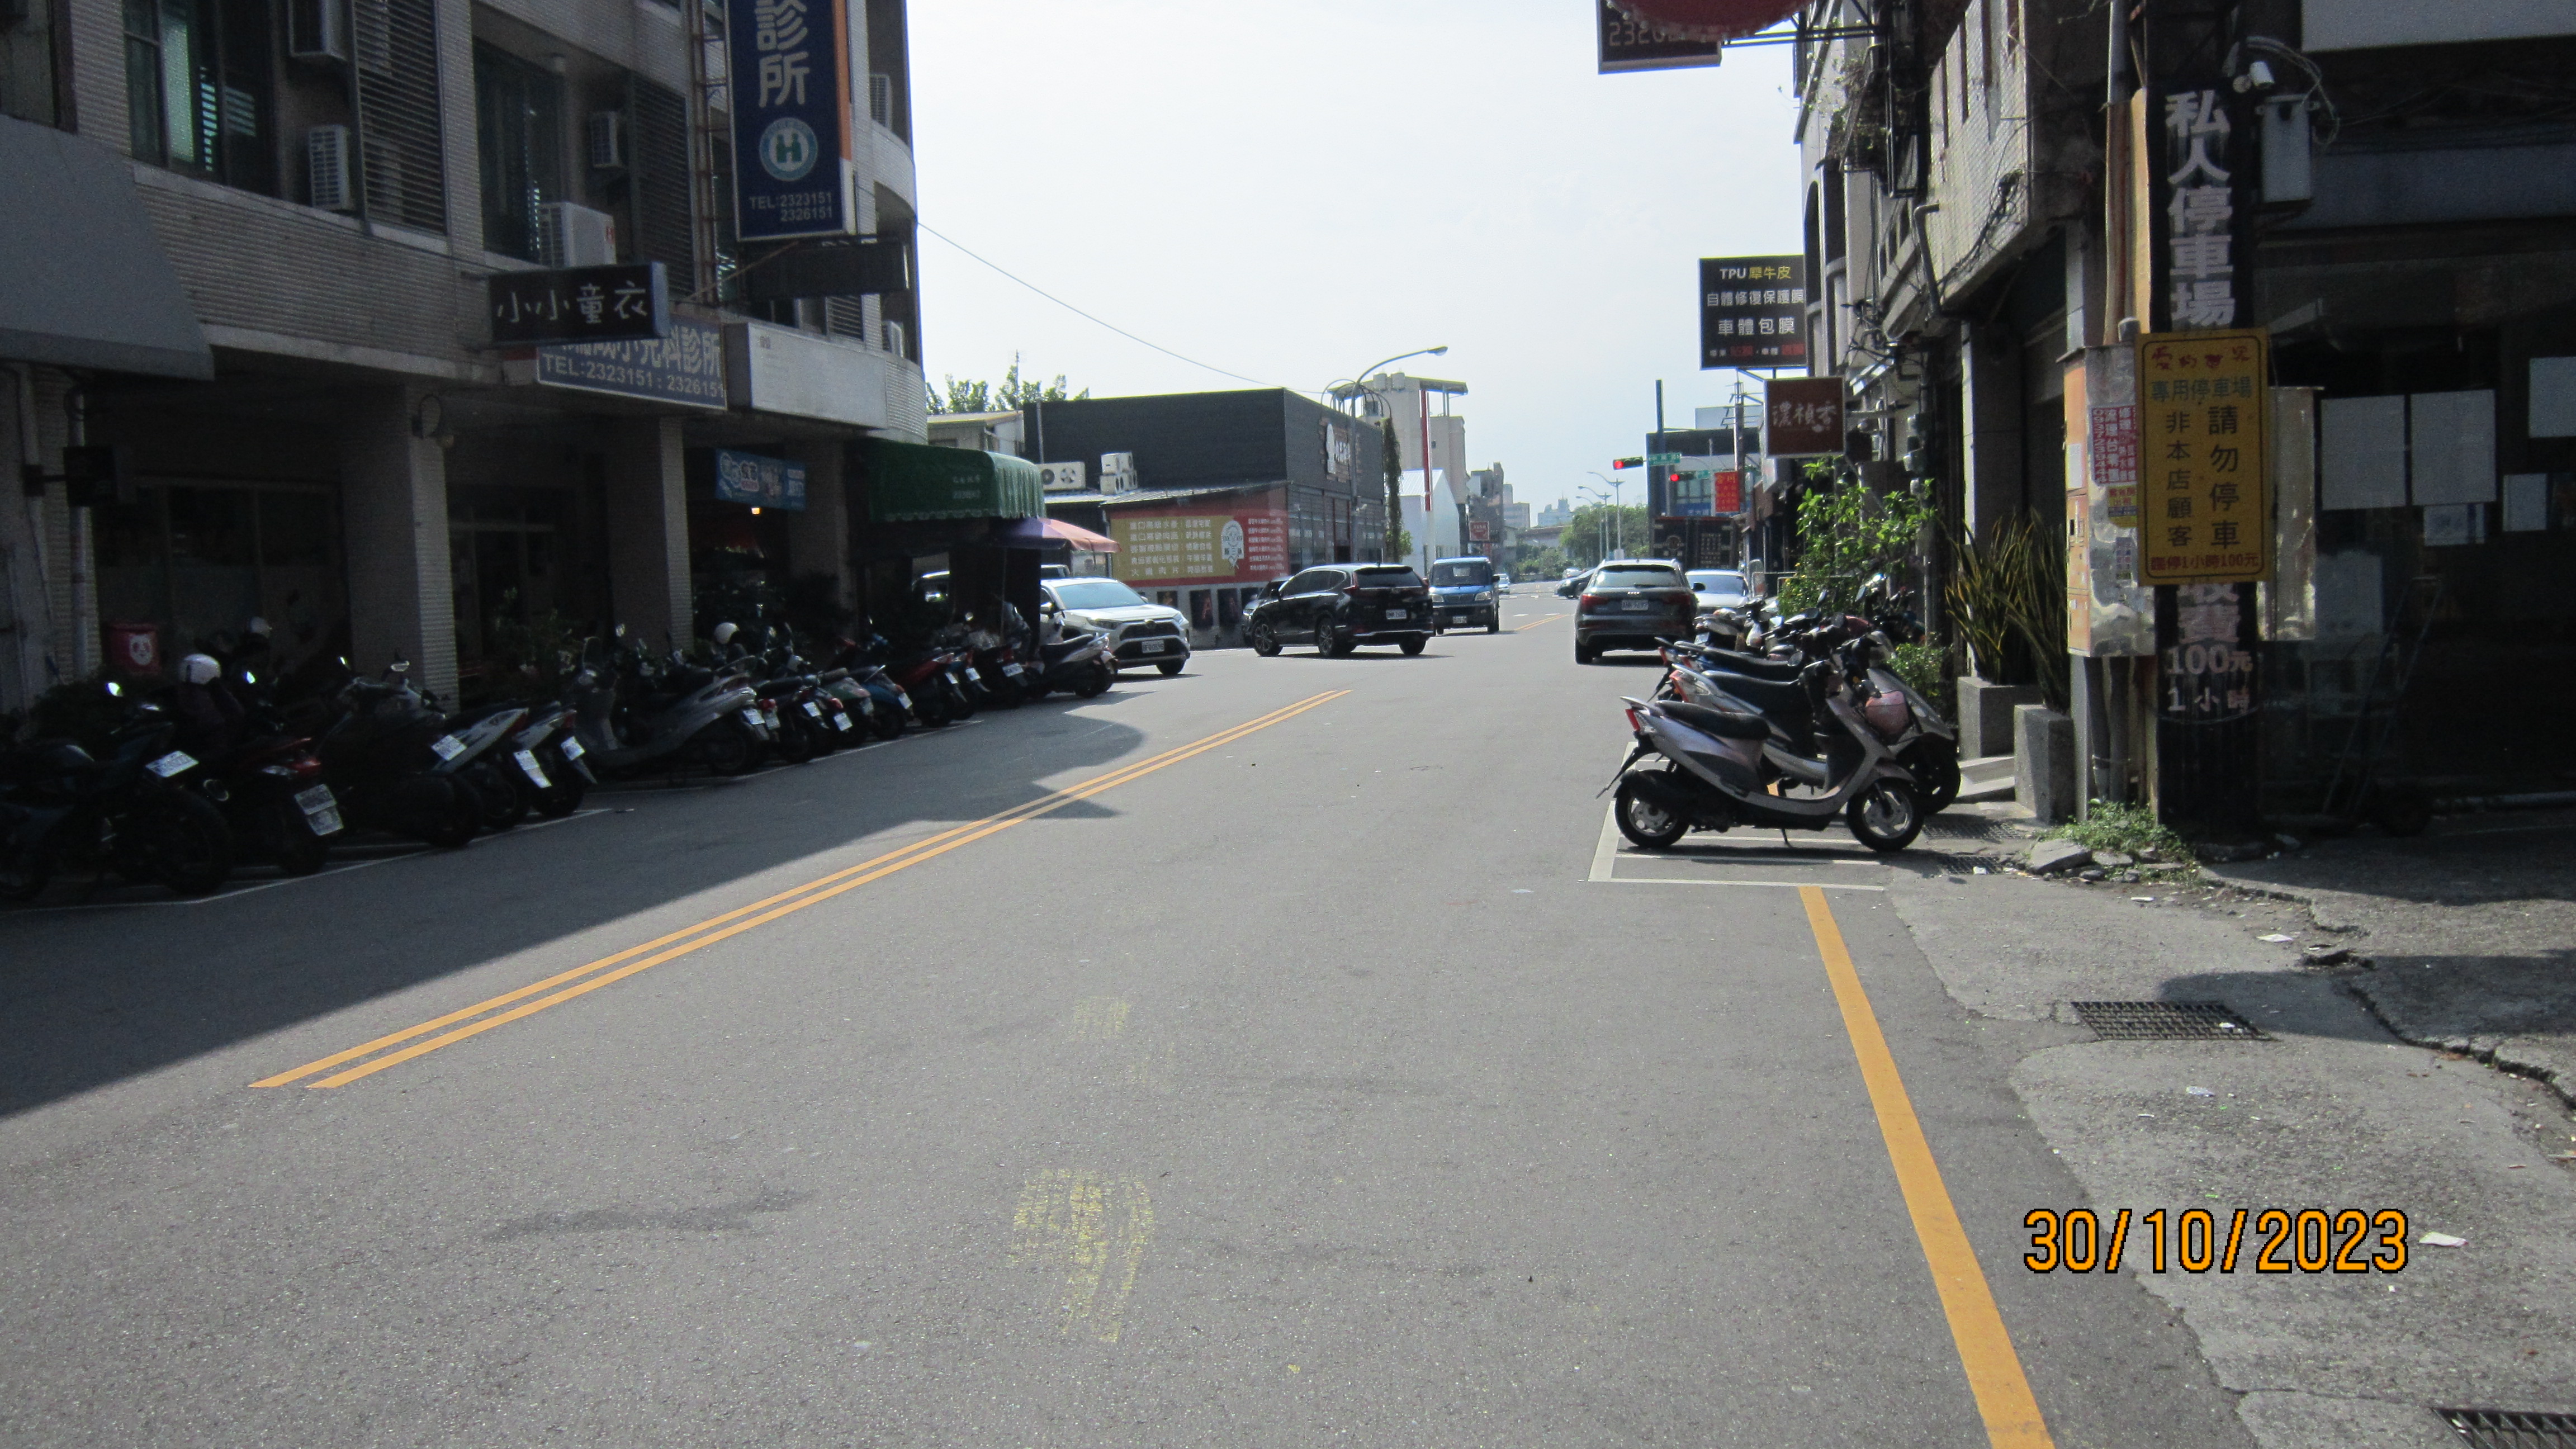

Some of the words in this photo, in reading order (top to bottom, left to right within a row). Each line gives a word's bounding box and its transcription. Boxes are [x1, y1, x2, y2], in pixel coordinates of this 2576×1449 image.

[755, 0, 810, 107] 診所
[2165, 89, 2235, 327] 私人停車場
[1720, 267, 1746, 280] TPU
[1749, 266, 1792, 280] 犀牛皮
[496, 281, 649, 324] 小小童衣
[1707, 288, 1805, 307] 自體修復保護膜
[1718, 318, 1796, 336] 車體包膜
[2150, 376, 2253, 403] 專用停車場
[2166, 411, 2193, 547] 非本店顧客
[2208, 405, 2241, 550] 請勿停車
[2166, 644, 2253, 675] 100元
[2167, 686, 2251, 714] 1小時
